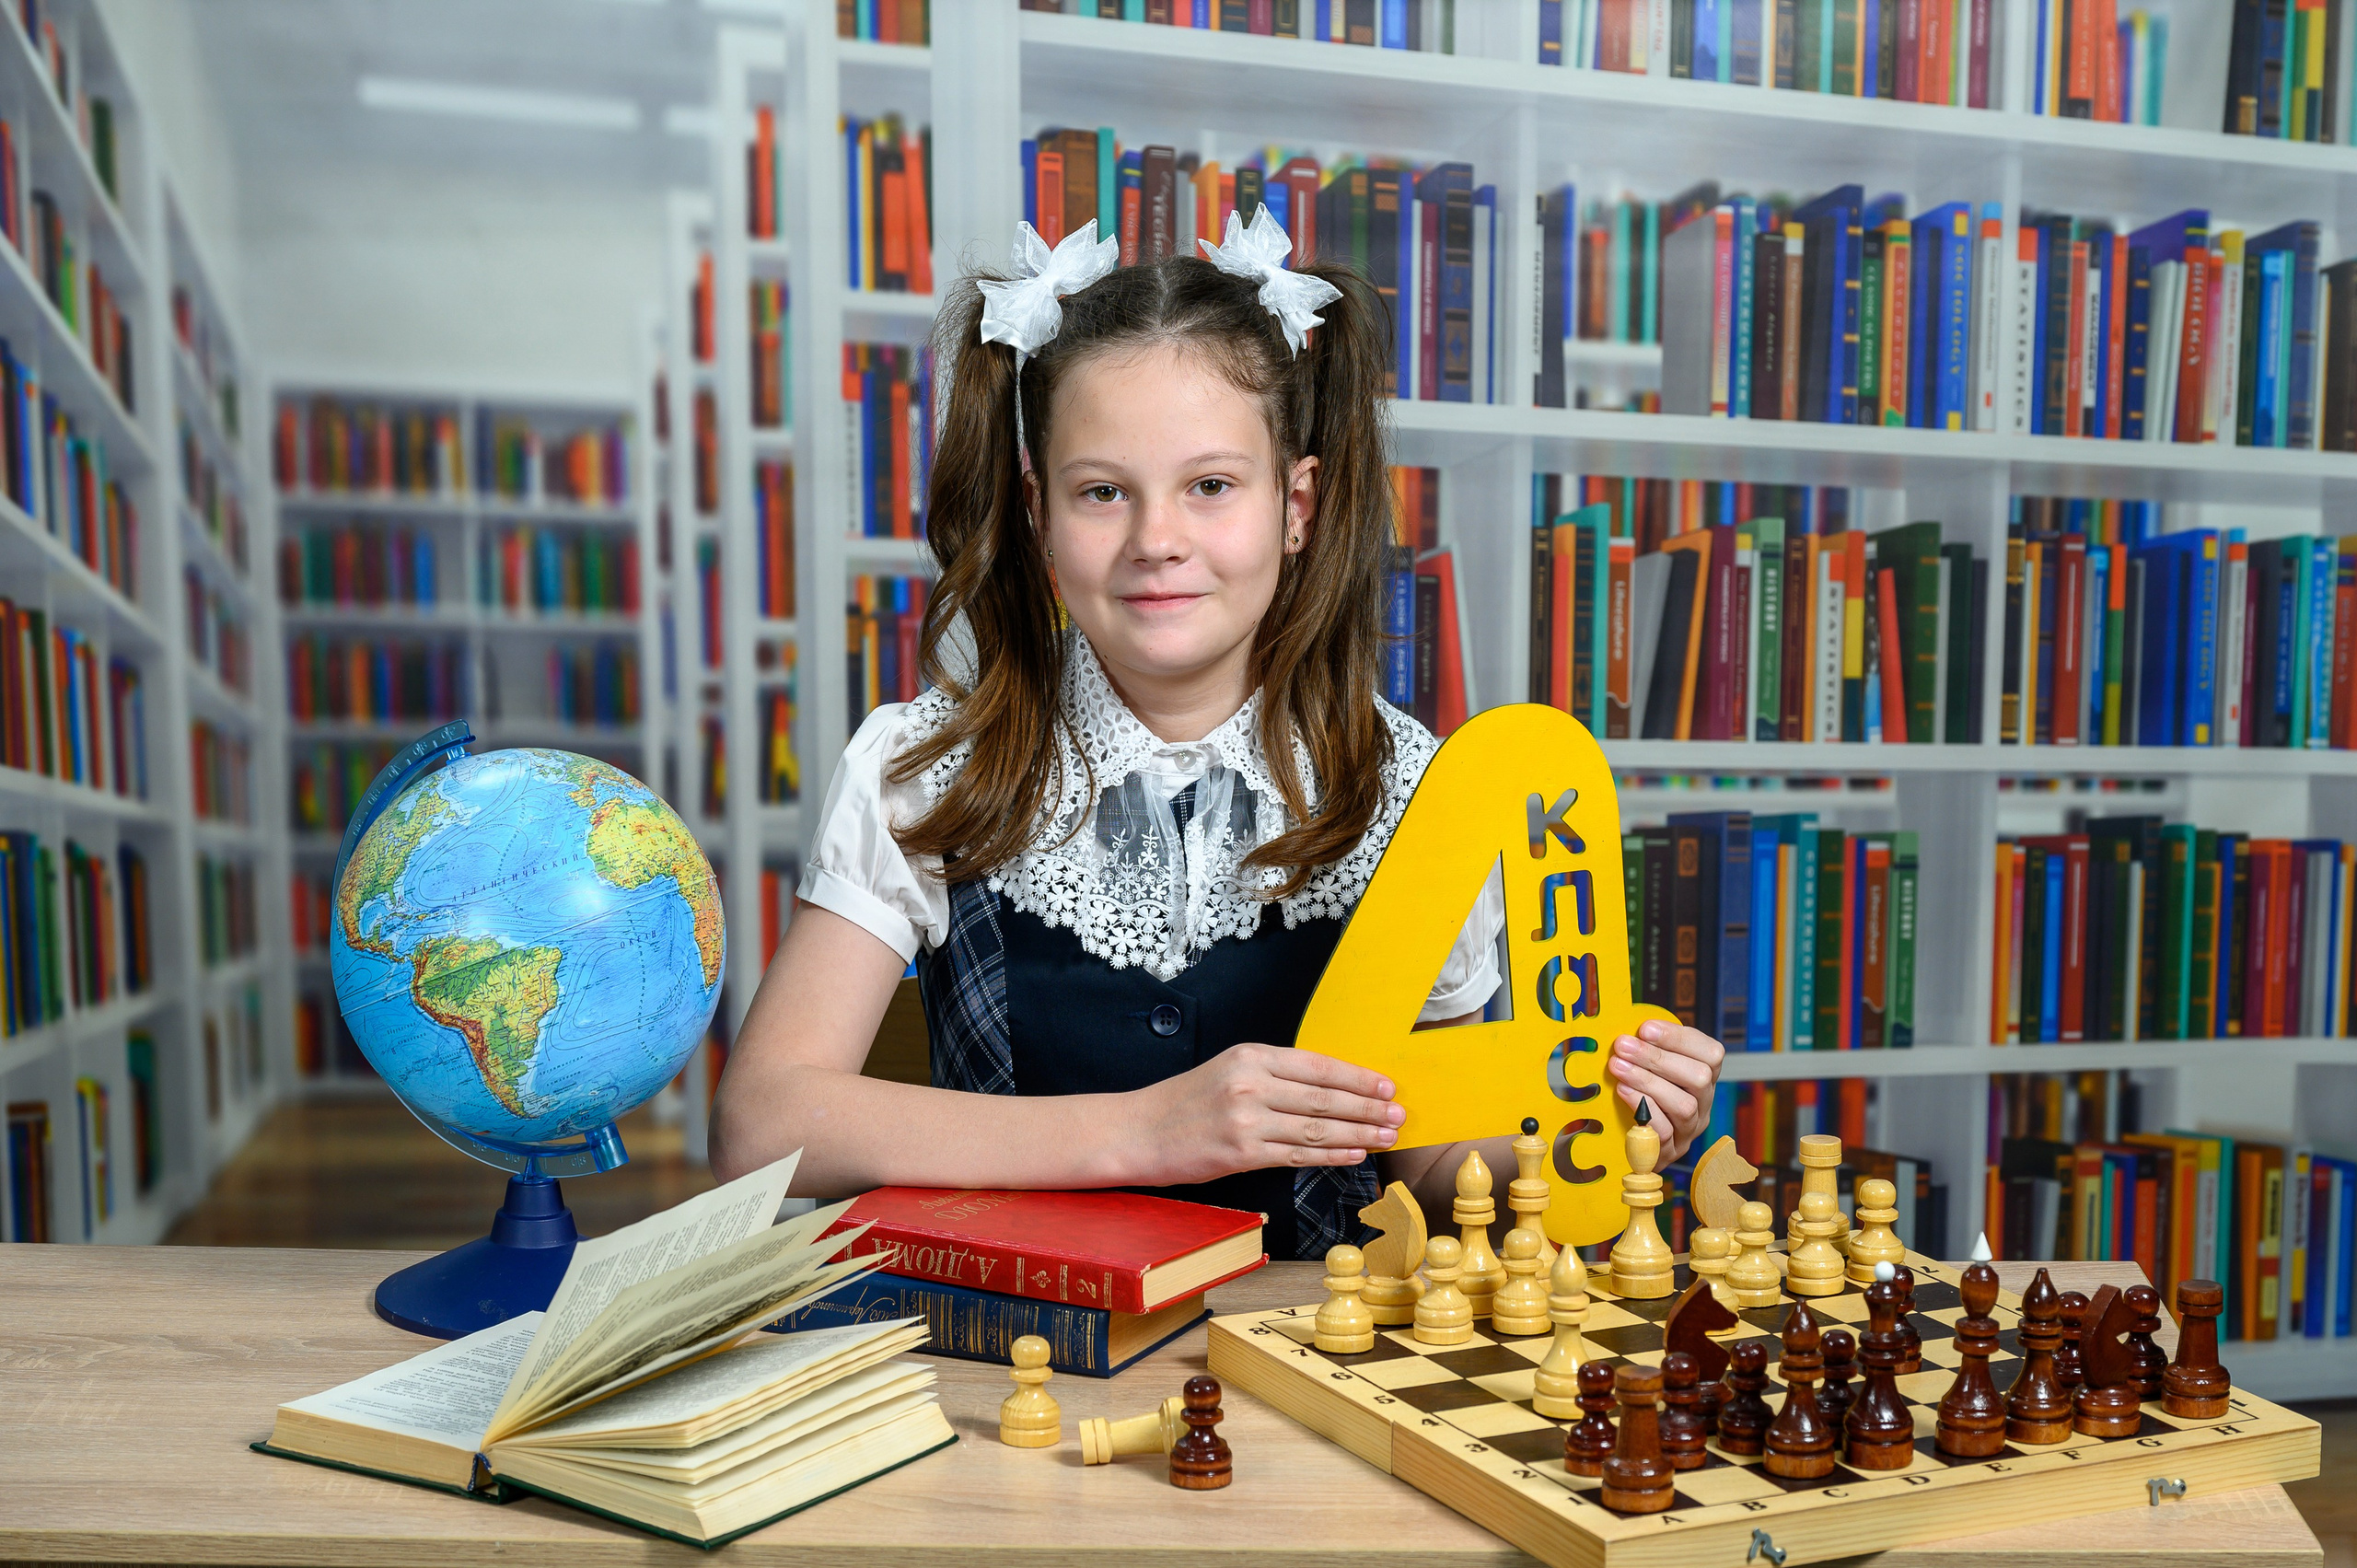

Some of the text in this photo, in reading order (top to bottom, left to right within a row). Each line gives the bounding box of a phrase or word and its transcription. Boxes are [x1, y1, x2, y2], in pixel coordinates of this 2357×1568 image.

[2014, 267, 2030, 430] STATISTICS
[1764, 568, 1780, 633] HISTORY
[1612, 580, 1628, 661] Literature
[1825, 587, 1840, 734] STATISTICS
[452, 853, 578, 903] АТЛАНТИЧЕСКИЙ
[1901, 879, 1914, 940] HISTORY
[1868, 884, 1883, 965] Literature
[620, 930, 656, 949] ОКЕАН
[1801, 850, 1816, 1024] CONSTRUCTION
[1648, 924, 1661, 992] Algebra
[1075, 1278, 1097, 1299] 2
[1273, 1308, 1298, 1317] A
[1248, 1327, 1271, 1336] 8
[1290, 1348, 1308, 1358] 7
[1330, 1372, 1353, 1380] 6
[1373, 1394, 1397, 1405] 5
[1421, 1418, 1445, 1427] 4
[1464, 1442, 1489, 1454] 3
[1512, 1469, 1538, 1480] 2
[1661, 1425, 2245, 1526] A B C D E F G H
[1565, 1496, 1584, 1506] 1
